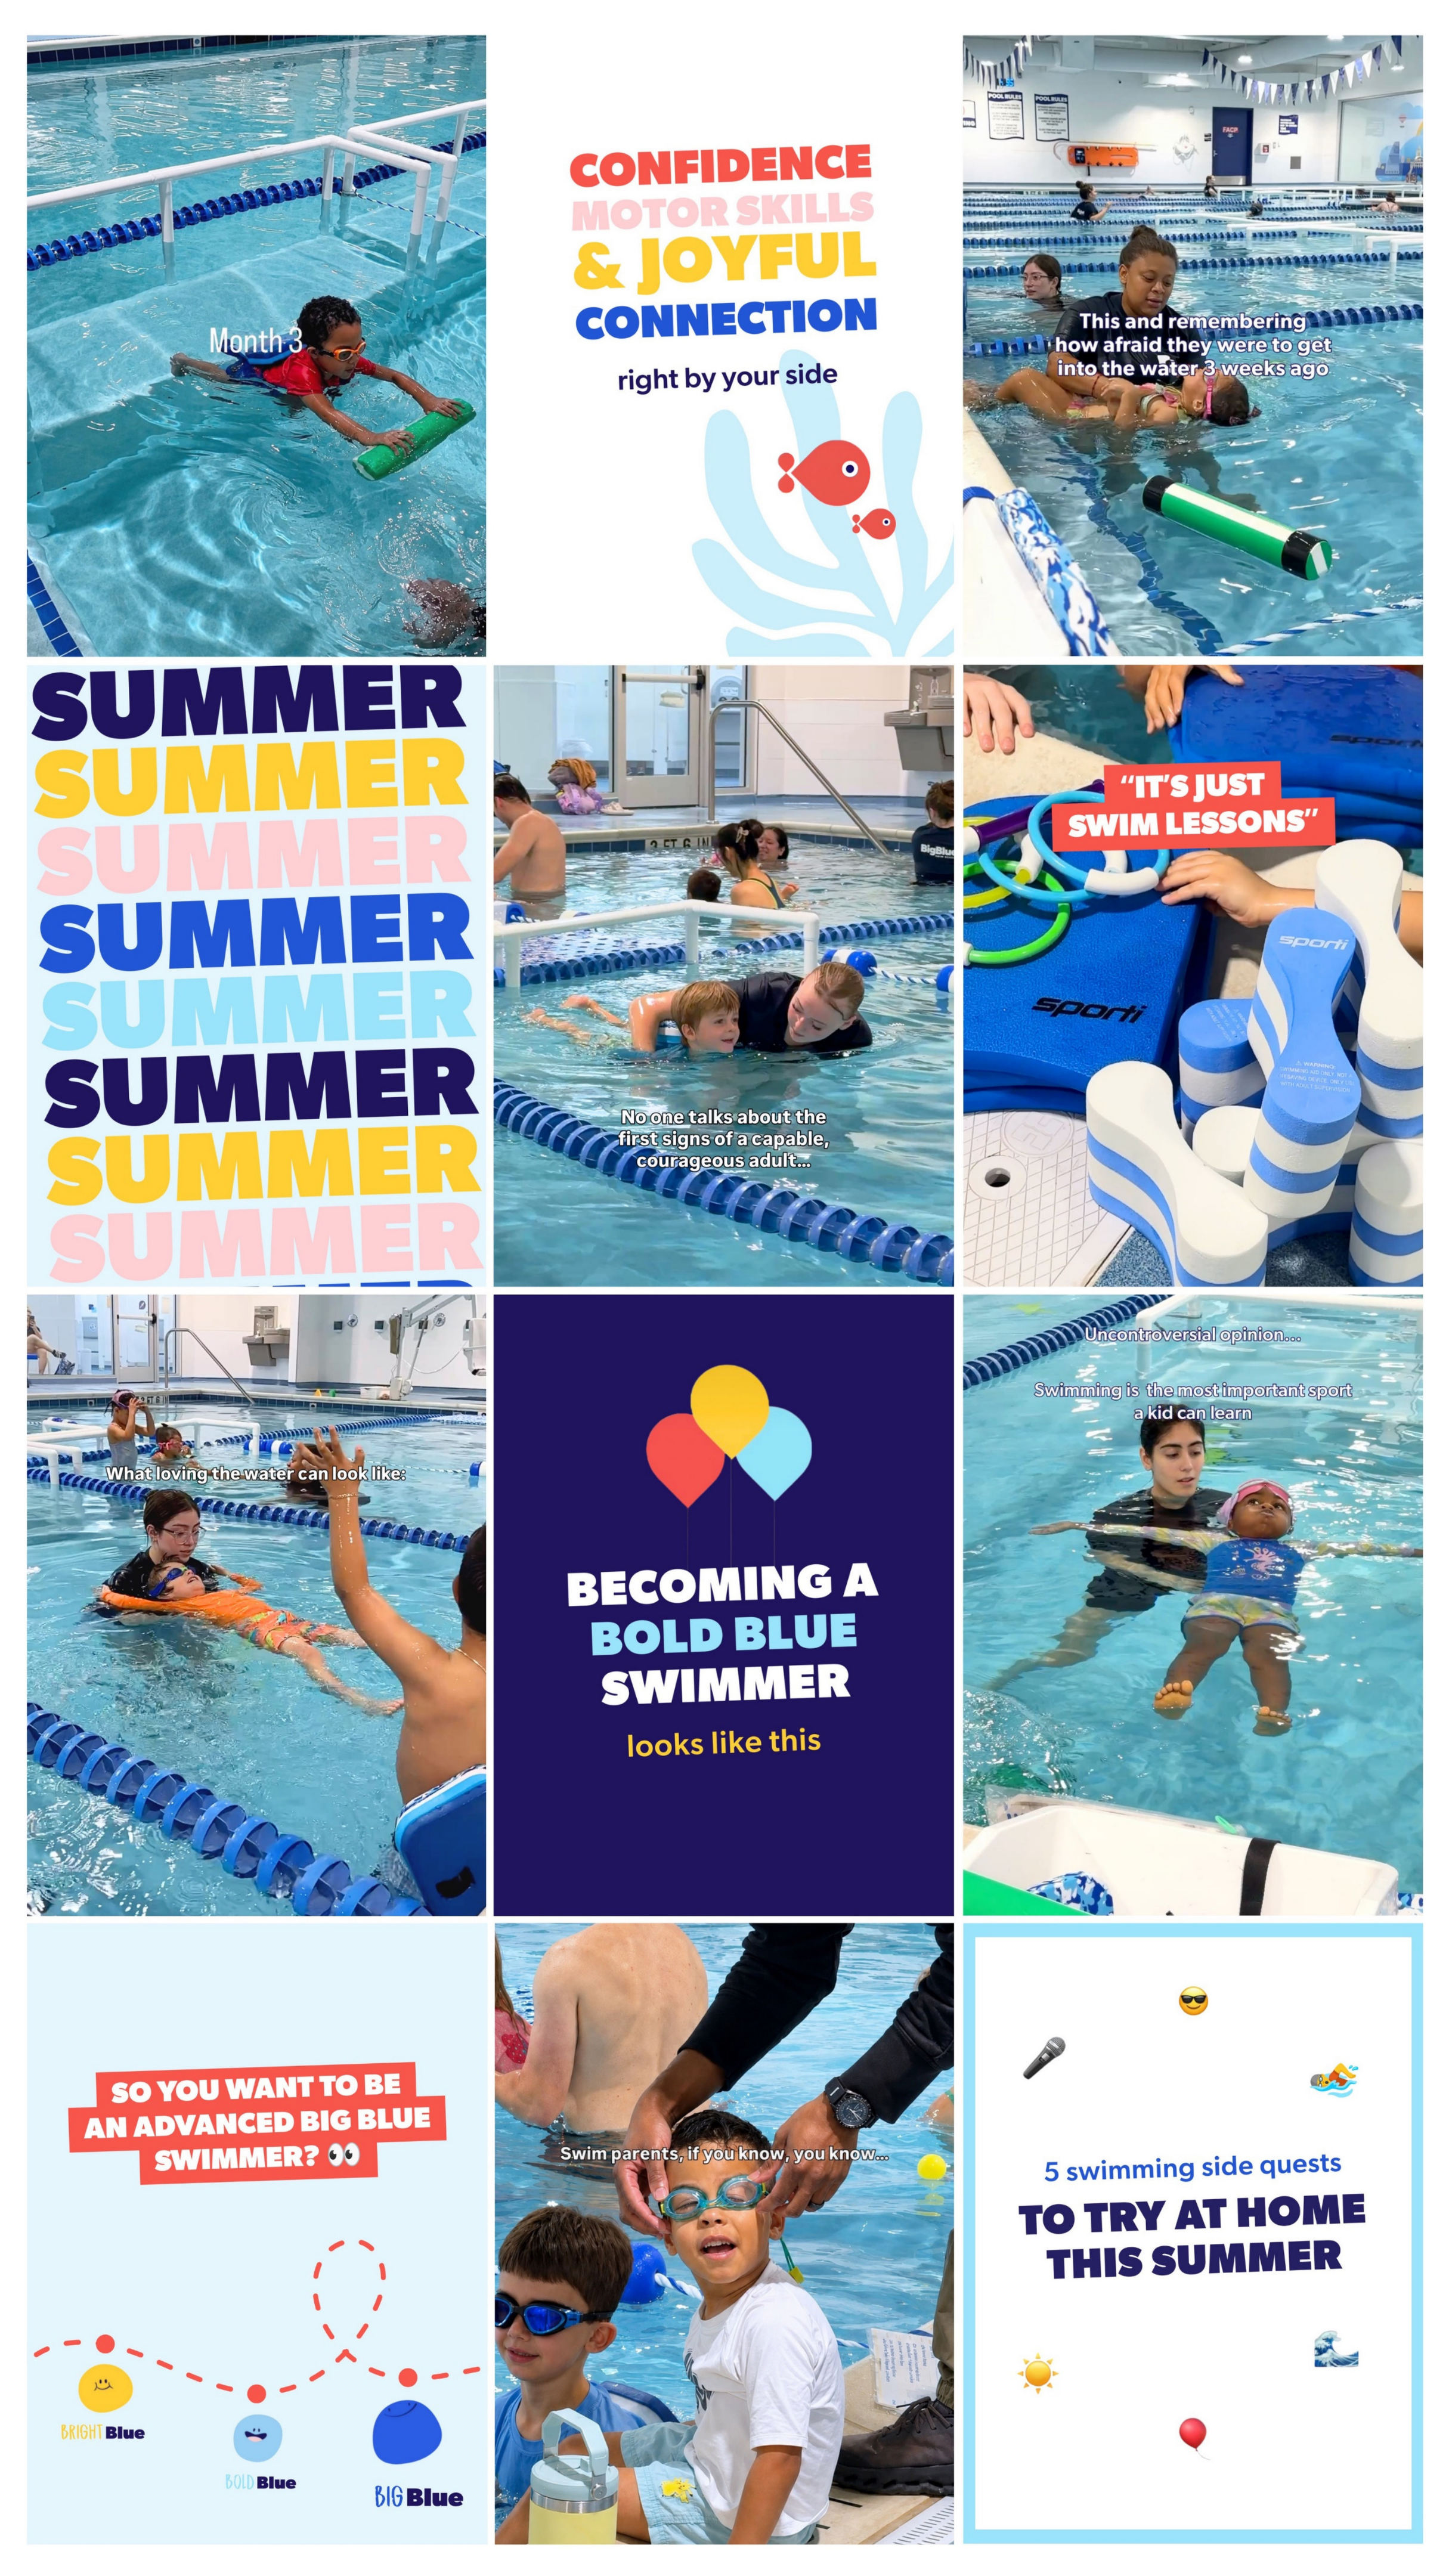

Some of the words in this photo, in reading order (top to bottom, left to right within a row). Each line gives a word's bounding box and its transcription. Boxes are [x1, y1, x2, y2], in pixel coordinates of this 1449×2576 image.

[569, 144, 872, 188] CONFIDENCE
[572, 197, 729, 231] MOTOR
[736, 191, 874, 225] SKILLS
[574, 242, 626, 290] &
[637, 231, 877, 295] JOYFUL
[575, 298, 877, 340] CONNECTION
[619, 369, 678, 395] right
[685, 368, 716, 392] by
[722, 370, 779, 392] your
[786, 363, 837, 385] side
[31, 665, 467, 741] SUMMER
[1330, 735, 1423, 747] sport
[34, 738, 469, 819] SUMMER
[1193, 773, 1265, 803] JUST
[664, 839, 677, 848] FT
[683, 838, 691, 847] 6
[698, 837, 708, 847] IN
[1069, 812, 1159, 837] SWIM
[36, 816, 472, 896] SUMMER
[39, 893, 474, 974] SUMMER
[1278, 935, 1349, 950] sporti
[42, 970, 477, 1051] SUMMER
[1032, 997, 1148, 1023] sporti
[44, 1048, 479, 1129] SUMMER
[1315, 1084, 1351, 1092] SUPERVISION
[47, 1125, 482, 1206] SUMMER
[49, 1202, 484, 1284] SUMMER
[568, 1564, 832, 1606] BECOMING
[843, 1563, 879, 1597] A
[592, 1618, 723, 1655] BOLD
[735, 1613, 857, 1651] BLUE
[602, 1664, 851, 1705] SWIMMER
[628, 1733, 703, 1757] looks
[712, 1730, 761, 1754] like
[769, 1727, 821, 1752] this
[112, 2082, 151, 2103] SO
[157, 2079, 219, 2101] YOU
[225, 2076, 314, 2099] WANT
[319, 2075, 358, 2096] TO
[365, 2073, 400, 2095] BE
[84, 2117, 126, 2138] AN
[134, 2112, 294, 2137] ADVANCED
[301, 2110, 351, 2131] BIG
[358, 2107, 430, 2129] BLUE
[155, 2145, 319, 2171] SWIMMER?
[1045, 2162, 1059, 2182] 5
[1067, 2157, 1194, 2182] swimming
[1202, 2155, 1253, 2176] side
[1260, 2154, 1342, 2179] quests
[1018, 2204, 1075, 2235] TO
[1083, 2200, 1166, 2233] TRY
[1174, 2198, 1227, 2230] AT
[1237, 2193, 1366, 2227] HOME
[1046, 2246, 1143, 2279] THIS
[1151, 2240, 1343, 2276] SUMMER
[61, 2424, 103, 2440] BRIGHT
[106, 2426, 145, 2439] Blue
[226, 2474, 254, 2490] BOLD
[257, 2476, 296, 2489] Blue
[375, 2485, 403, 2507] BIG
[407, 2488, 463, 2507] Blue
